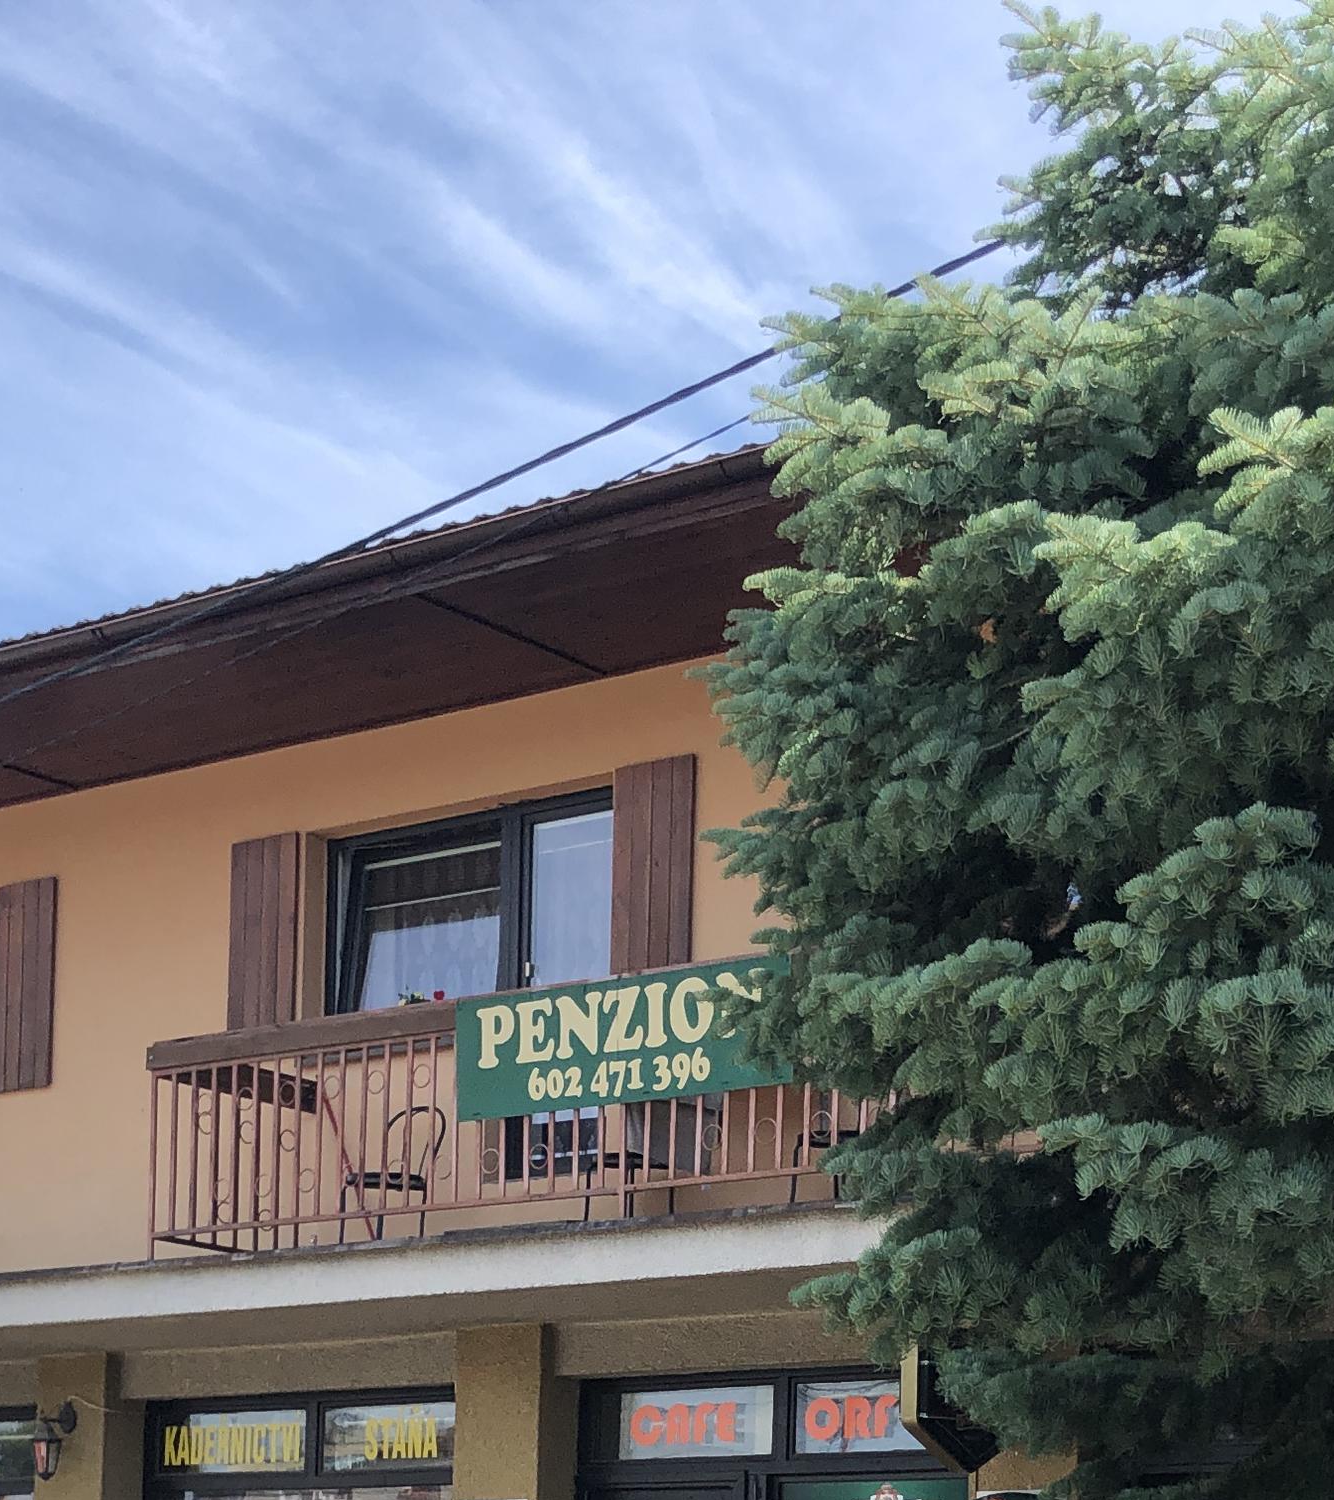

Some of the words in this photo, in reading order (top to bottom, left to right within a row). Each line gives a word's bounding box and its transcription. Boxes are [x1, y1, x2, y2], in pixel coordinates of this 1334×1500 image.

[527, 1066, 583, 1101] 602
[590, 1058, 645, 1098] 471
[652, 1047, 711, 1092] 396
[630, 1401, 738, 1447] CAFE
[804, 1393, 900, 1442] ORF
